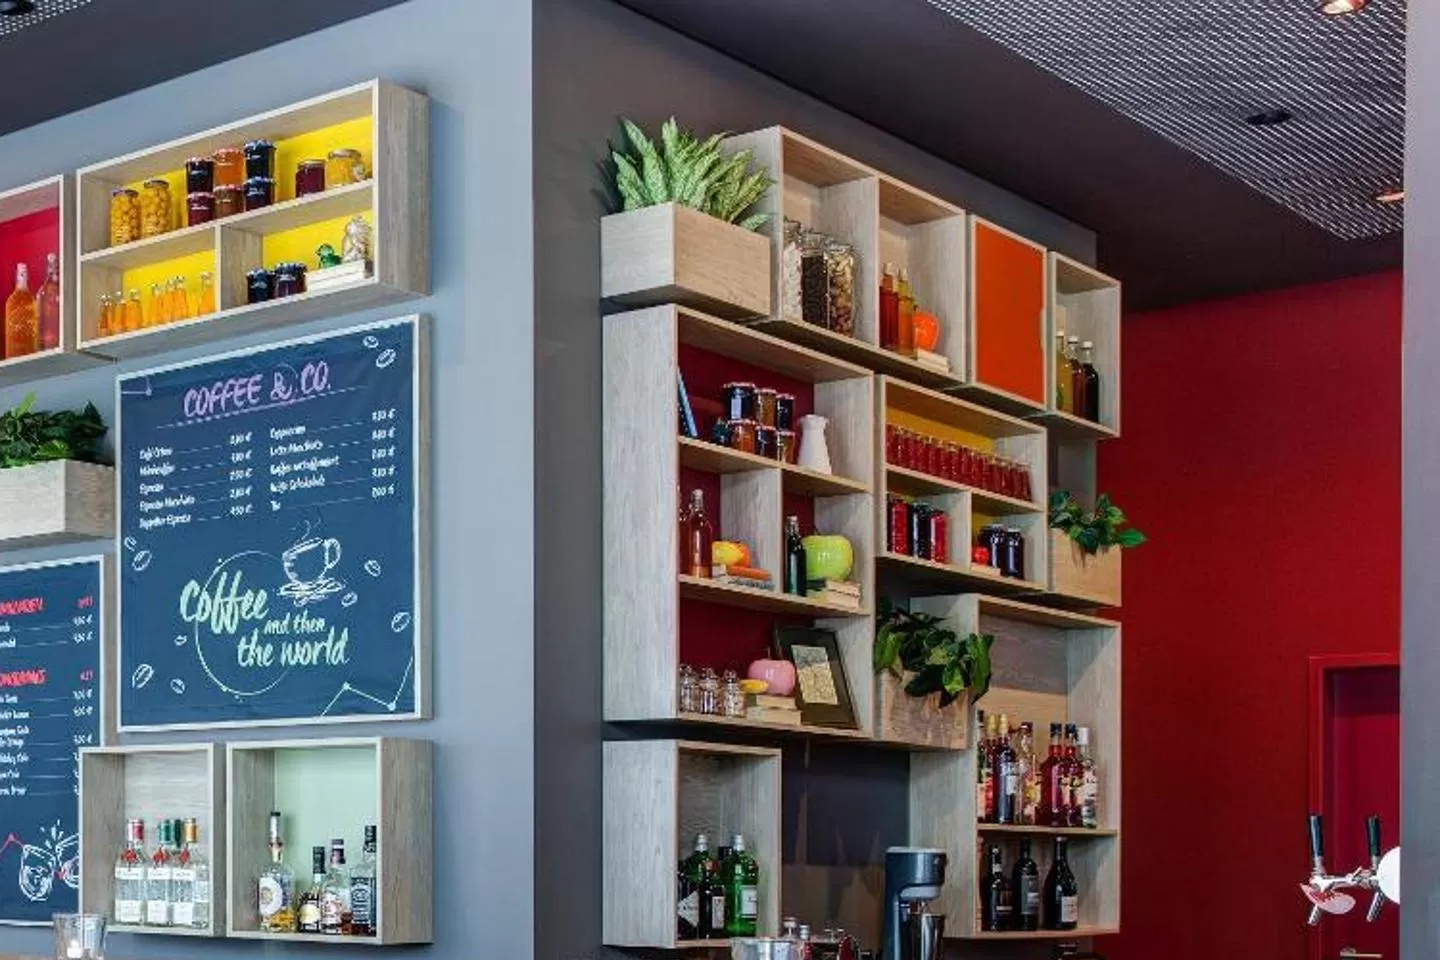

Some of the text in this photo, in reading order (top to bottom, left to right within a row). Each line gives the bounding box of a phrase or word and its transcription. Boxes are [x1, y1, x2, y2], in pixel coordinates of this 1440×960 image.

[183, 374, 263, 417] COFFEE
[270, 371, 292, 400] &
[179, 570, 270, 635] Coffee
[264, 608, 326, 635] and then
[237, 626, 351, 668] the world
